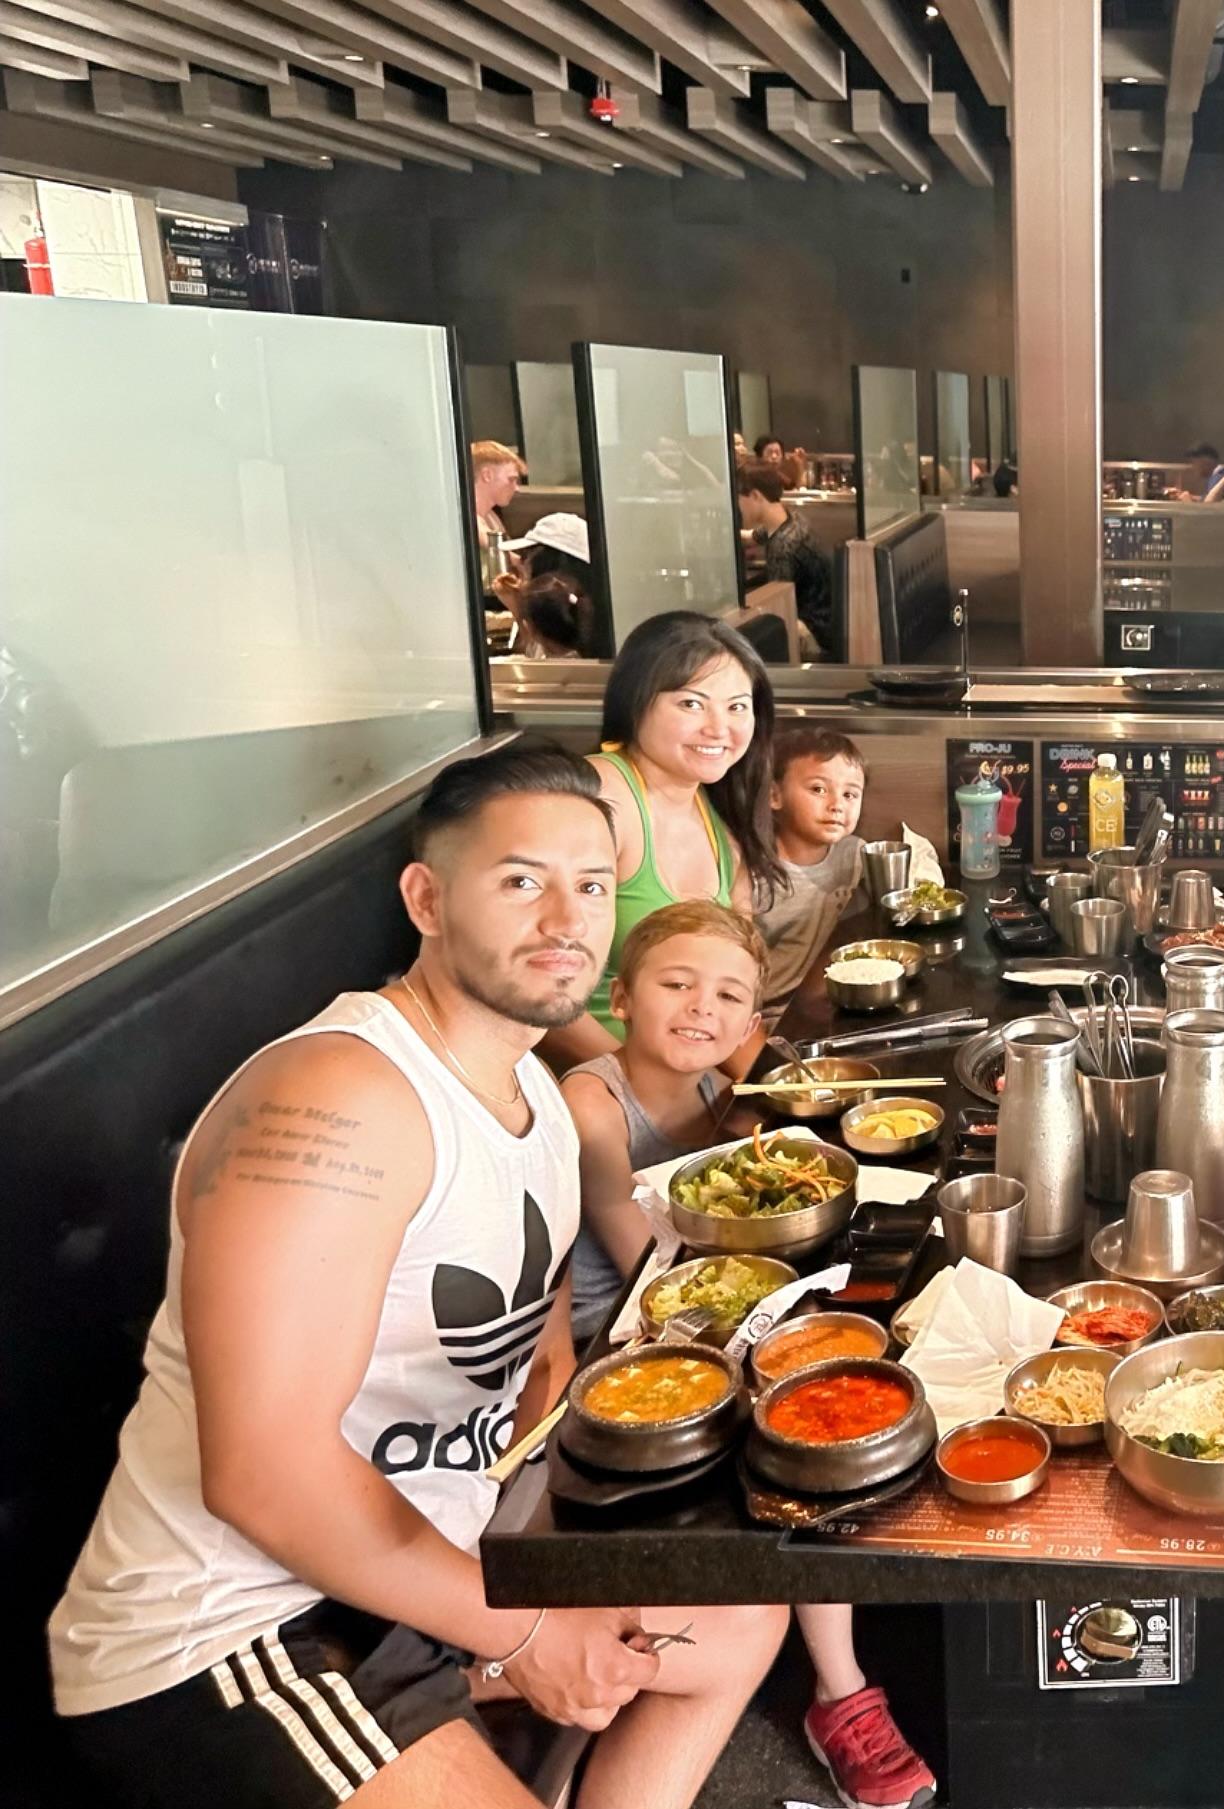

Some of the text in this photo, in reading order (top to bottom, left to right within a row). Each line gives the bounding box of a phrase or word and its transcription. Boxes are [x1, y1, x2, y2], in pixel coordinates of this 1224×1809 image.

[968, 743, 1012, 753] PRO-JU
[1049, 748, 1095, 760] DRINK
[1001, 763, 1030, 775] $9.95
[1060, 757, 1098, 772] Special
[817, 1523, 860, 1535] 42.95
[985, 1528, 1031, 1543] 34.95
[1160, 1537, 1206, 1551] 28.95
